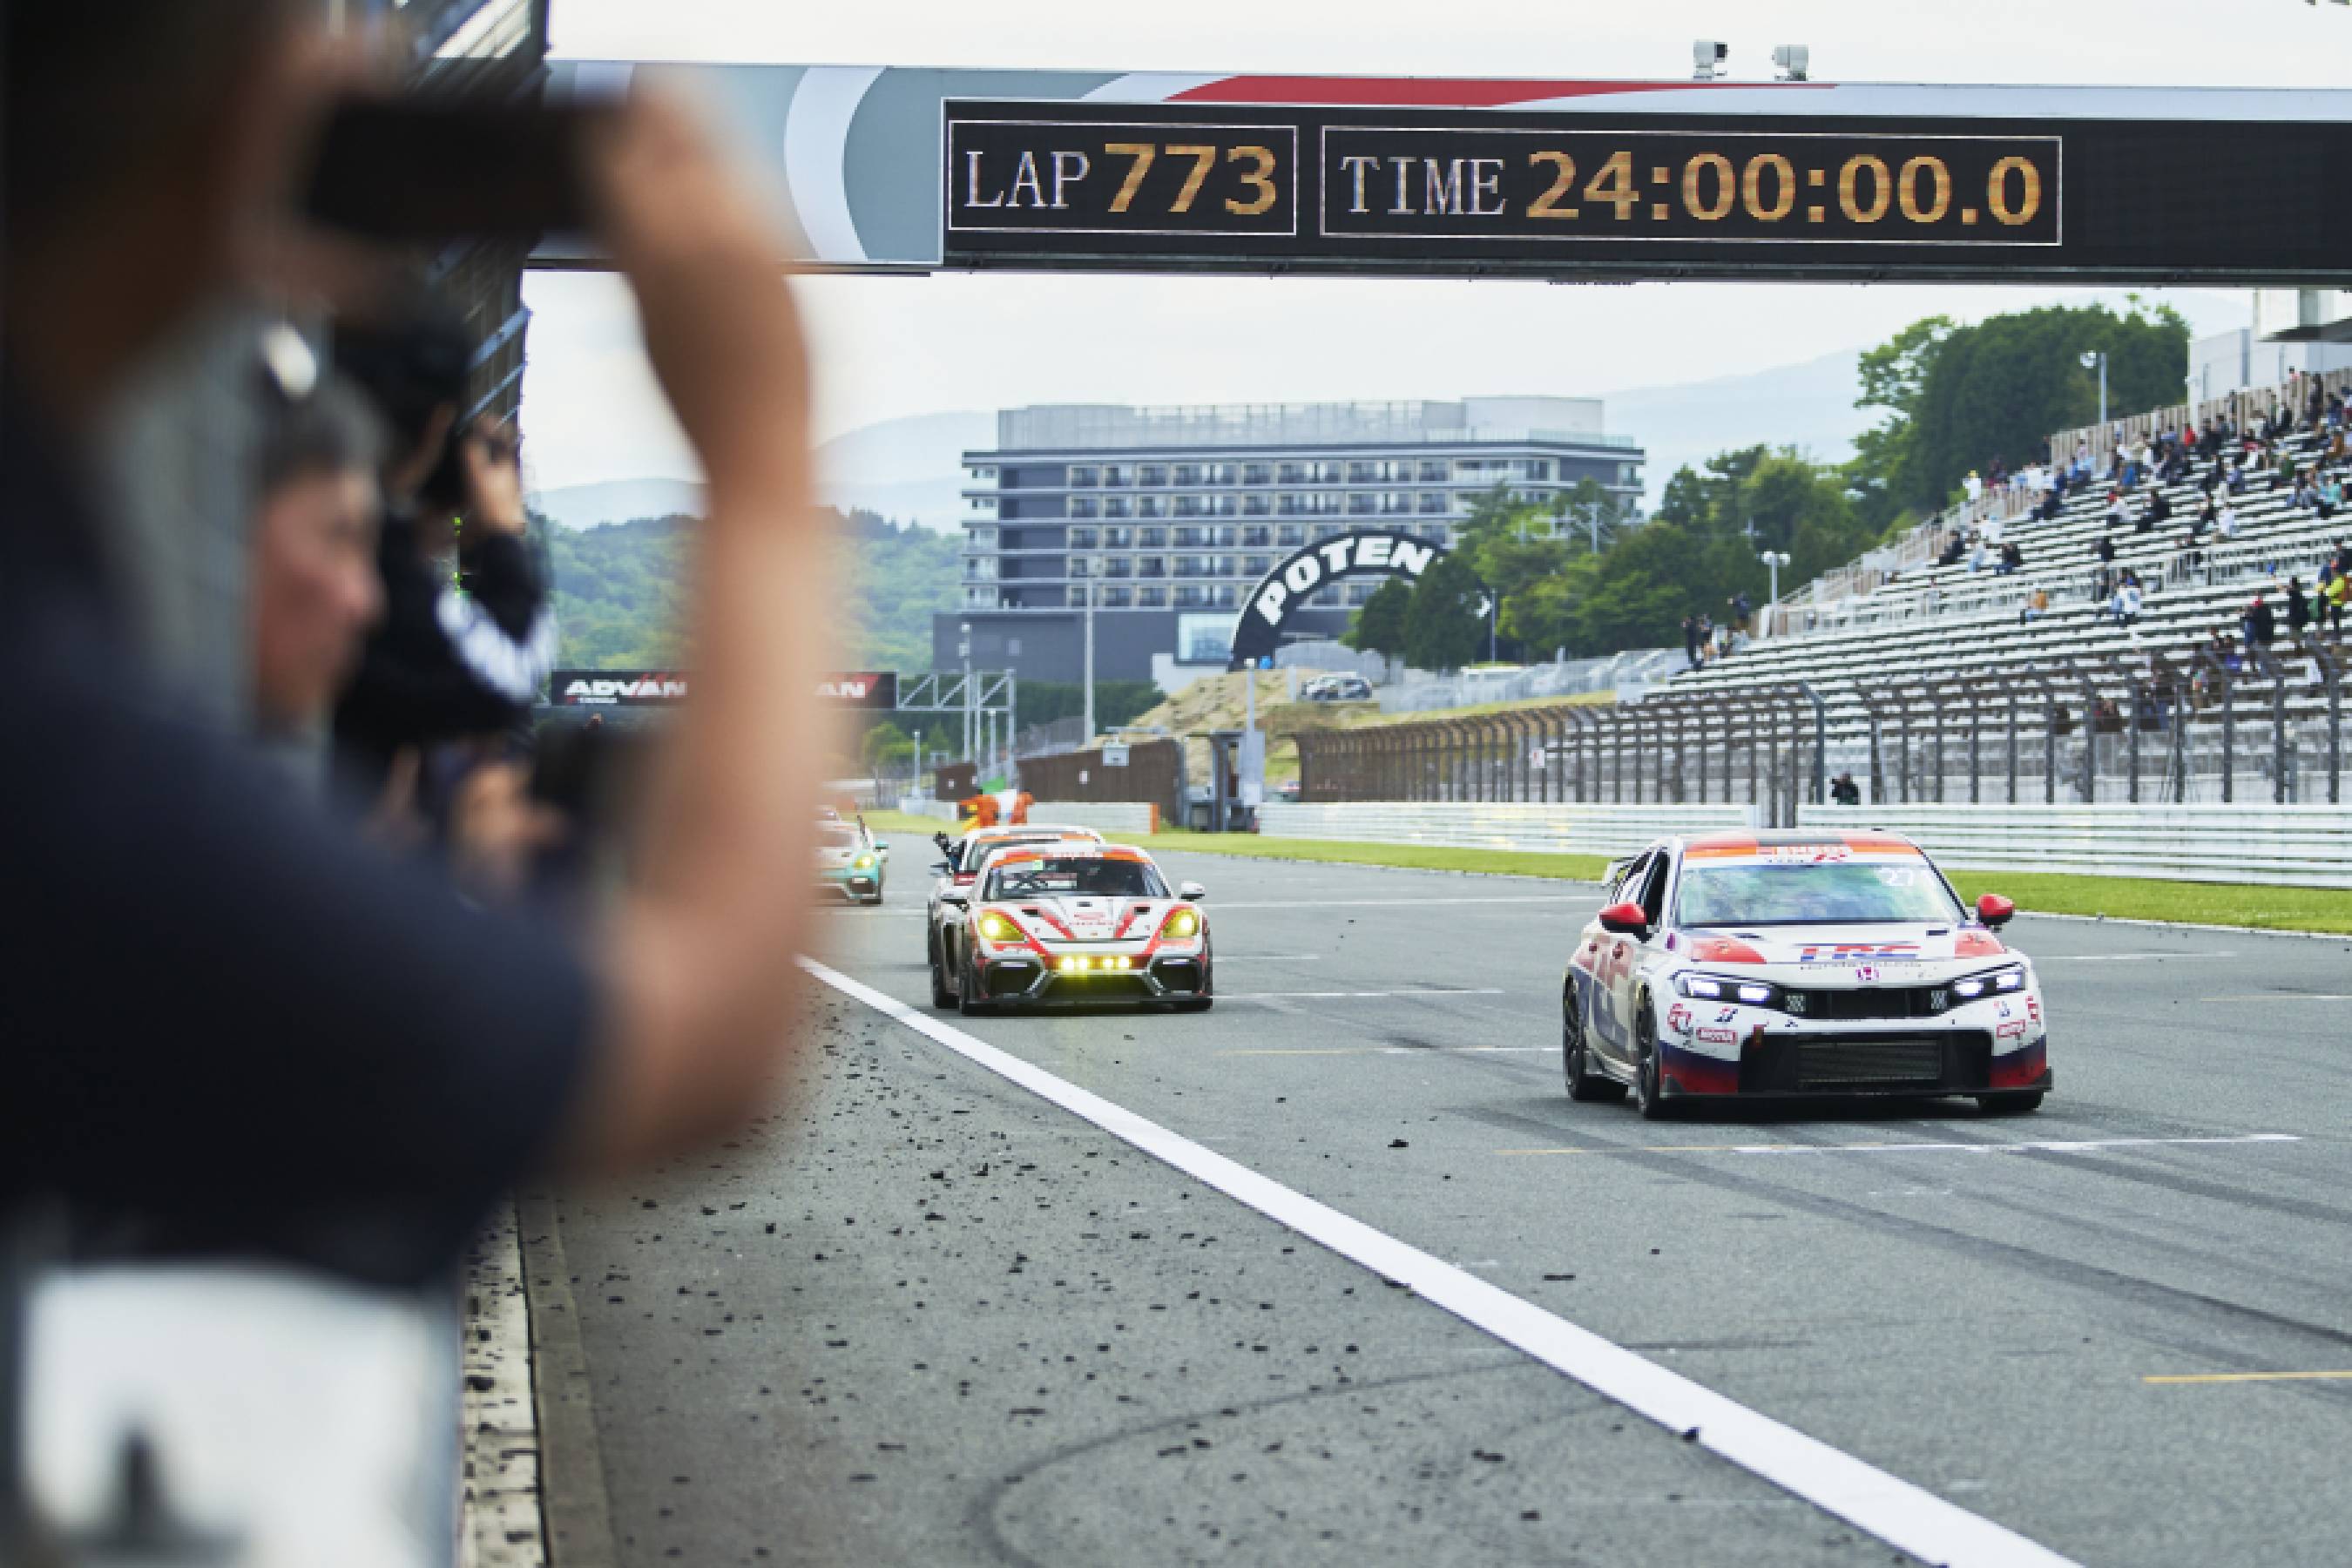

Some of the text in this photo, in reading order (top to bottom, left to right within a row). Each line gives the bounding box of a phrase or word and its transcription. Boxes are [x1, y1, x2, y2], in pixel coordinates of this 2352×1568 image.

[964, 143, 1278, 215] LAP 773
[1338, 150, 2043, 226] TIME 24:00:00.0
[1255, 536, 1492, 625] POTEN
[564, 679, 688, 697] ADVAN
